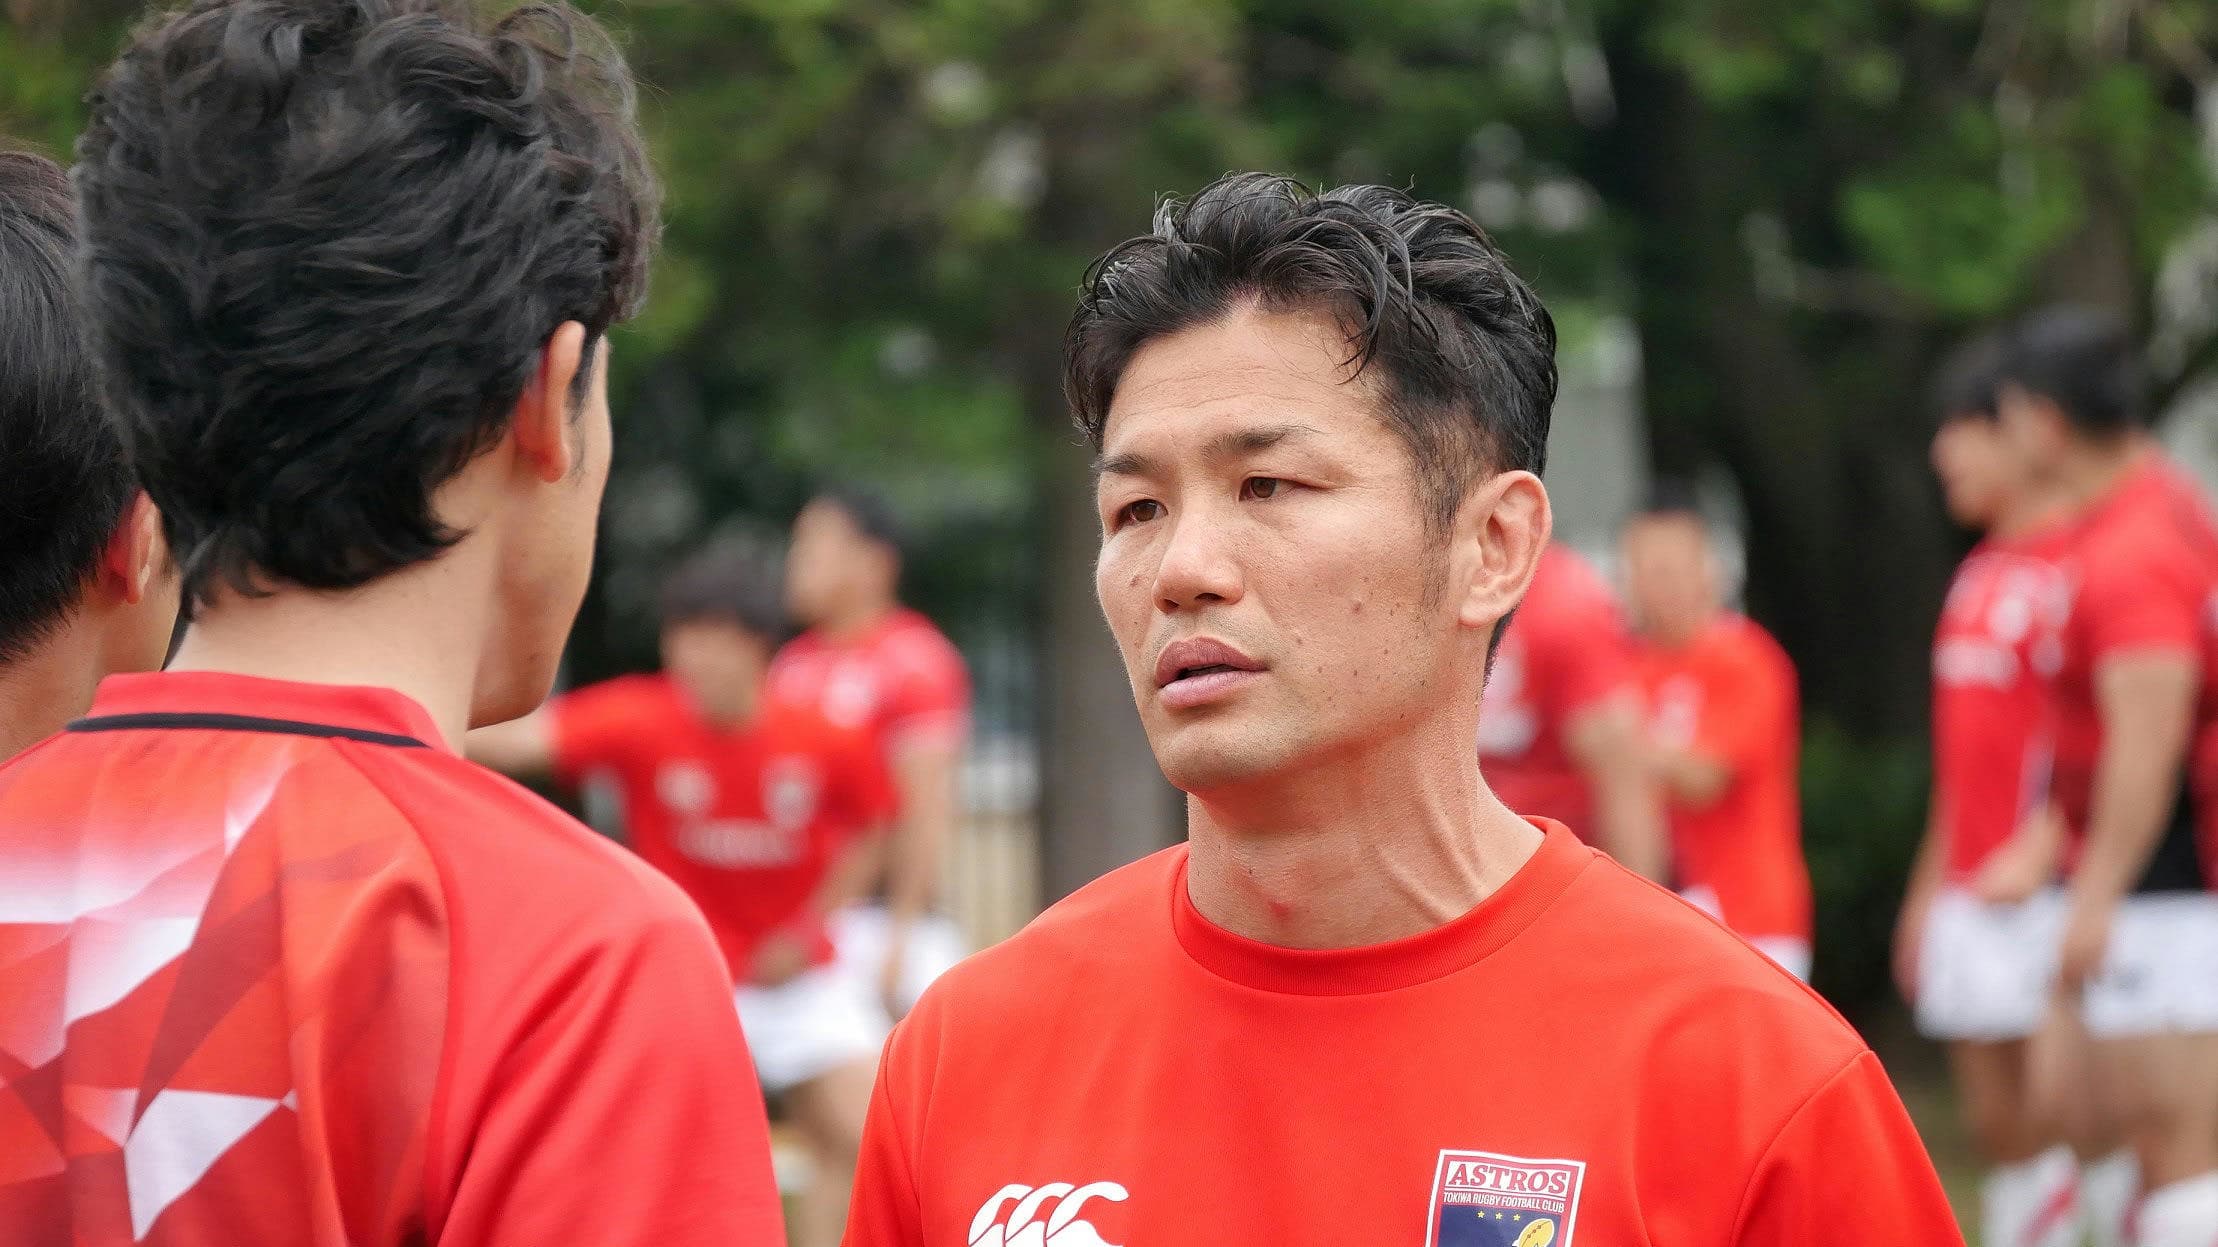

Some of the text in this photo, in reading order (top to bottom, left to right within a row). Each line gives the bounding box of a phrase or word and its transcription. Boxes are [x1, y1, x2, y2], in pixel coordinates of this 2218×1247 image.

[1448, 1163, 1567, 1194] ASTROS
[1443, 1191, 1565, 1213] TOKIWA RUGBY FOOTBALL CLUB
